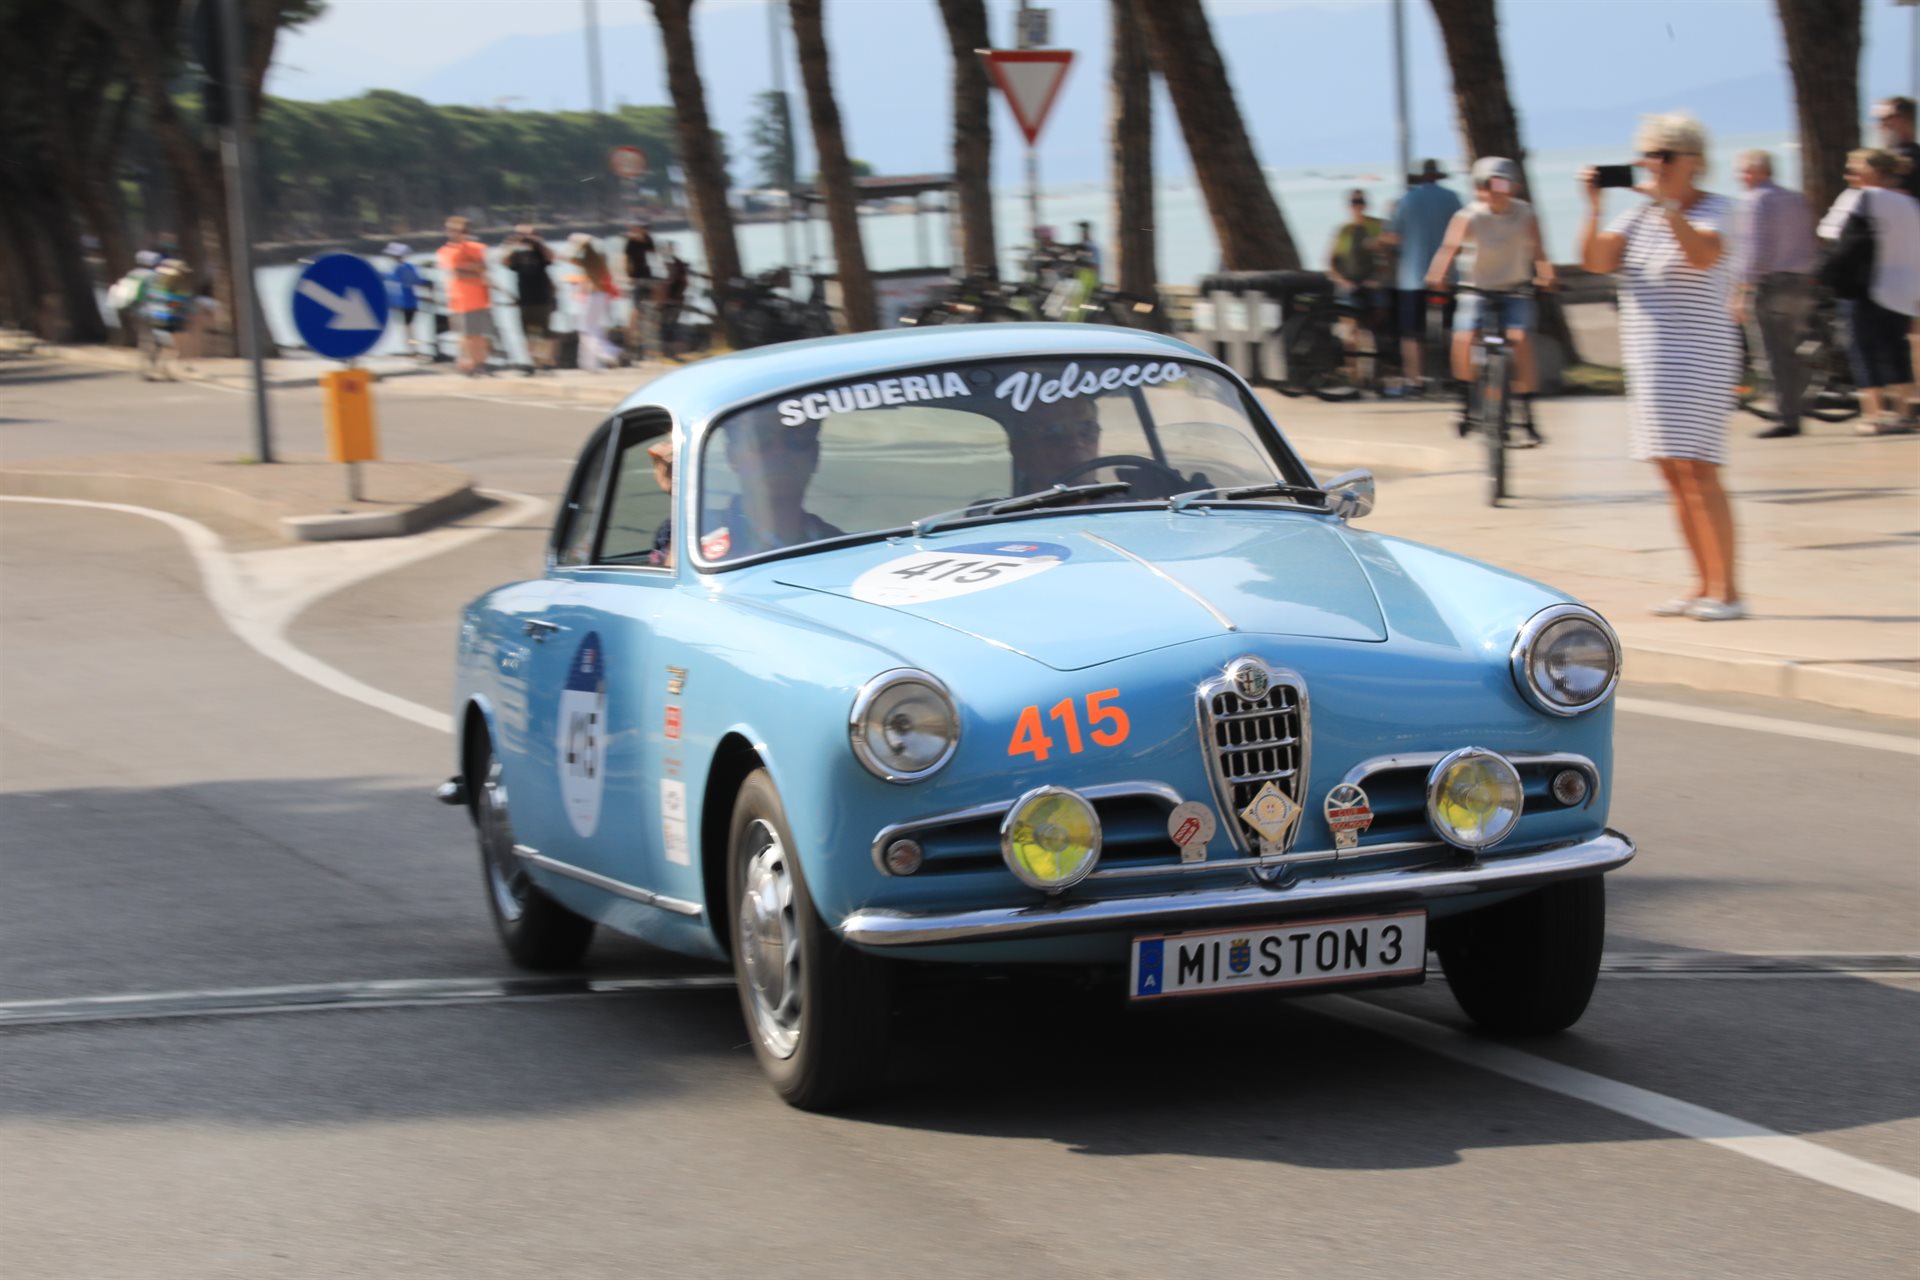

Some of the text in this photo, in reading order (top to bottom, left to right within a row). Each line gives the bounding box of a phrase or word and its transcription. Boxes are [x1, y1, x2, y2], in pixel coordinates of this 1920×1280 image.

[778, 362, 1187, 427] SCUDERIA Velsecco
[889, 558, 1022, 584] 415
[1007, 688, 1130, 762] 415
[1144, 924, 1403, 988] A MI STON 3
